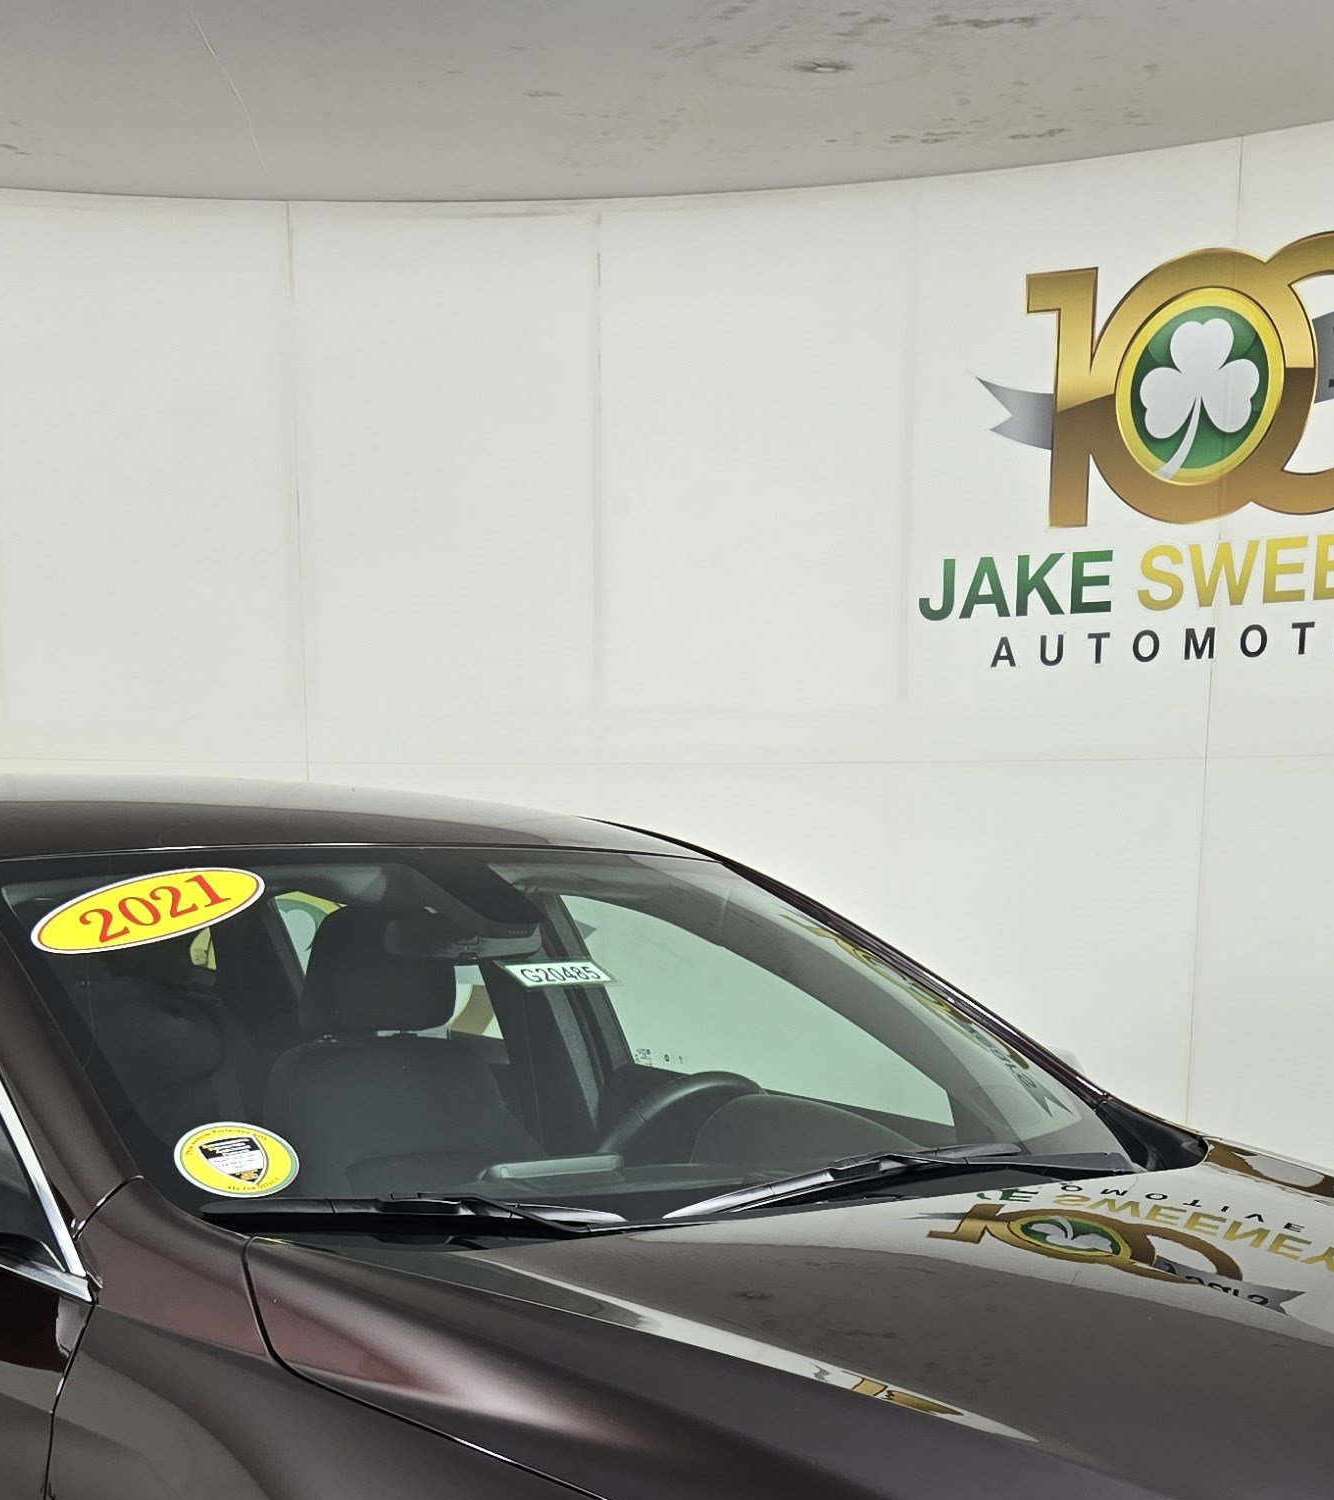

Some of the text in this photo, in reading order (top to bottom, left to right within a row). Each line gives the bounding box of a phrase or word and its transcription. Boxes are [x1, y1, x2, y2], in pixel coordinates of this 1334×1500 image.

[918, 550, 1114, 621] JAKE
[78, 874, 232, 944] 2021
[520, 966, 602, 983] G20485
